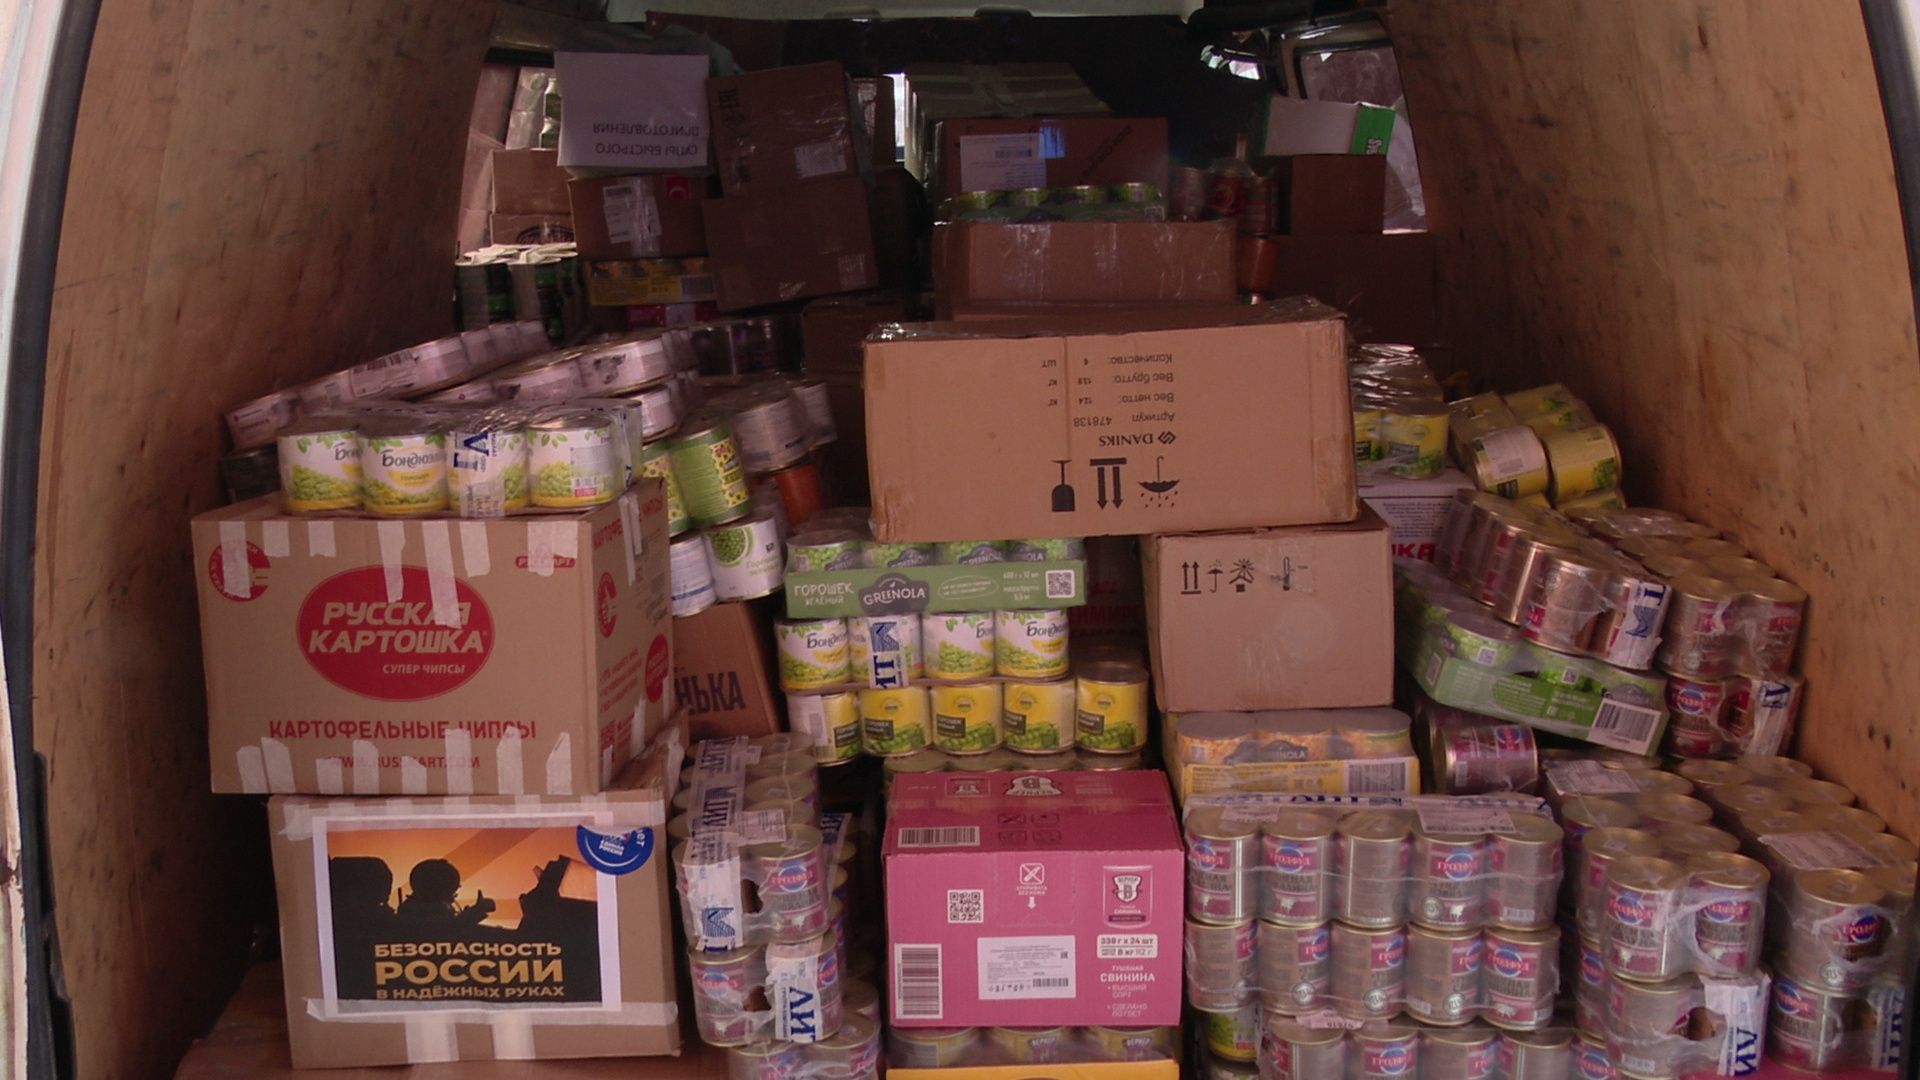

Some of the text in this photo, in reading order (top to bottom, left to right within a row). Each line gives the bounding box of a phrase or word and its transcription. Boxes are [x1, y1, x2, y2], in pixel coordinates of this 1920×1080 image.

[593, 123, 699, 137] ПРИГОТОВЛЕНИЯ
[594, 143, 662, 156] БЫСТРОГО
[1153, 372, 1174, 383] Вес
[1153, 392, 1174, 403] Вес
[1073, 411, 1175, 428] Артикул 478138
[1098, 433, 1154, 448] DANIKS
[794, 582, 855, 598] ГОРОШЕК
[863, 587, 926, 606] GREENOLA
[307, 629, 484, 655] КАРТОШКА
[382, 663, 466, 675] СУПЕР ЧИПСЫ
[269, 720, 449, 739] КАРТОФЕЛЬНЫЕ
[1130, 937, 1140, 945] 24
[374, 942, 562, 957] БЕЗОПАСНОСТЬ
[375, 958, 564, 985] РОССИИ
[1100, 972, 1156, 983] СВИНИНА
[375, 985, 565, 1000] В НАДЁЖНЫХ РУКАХ
